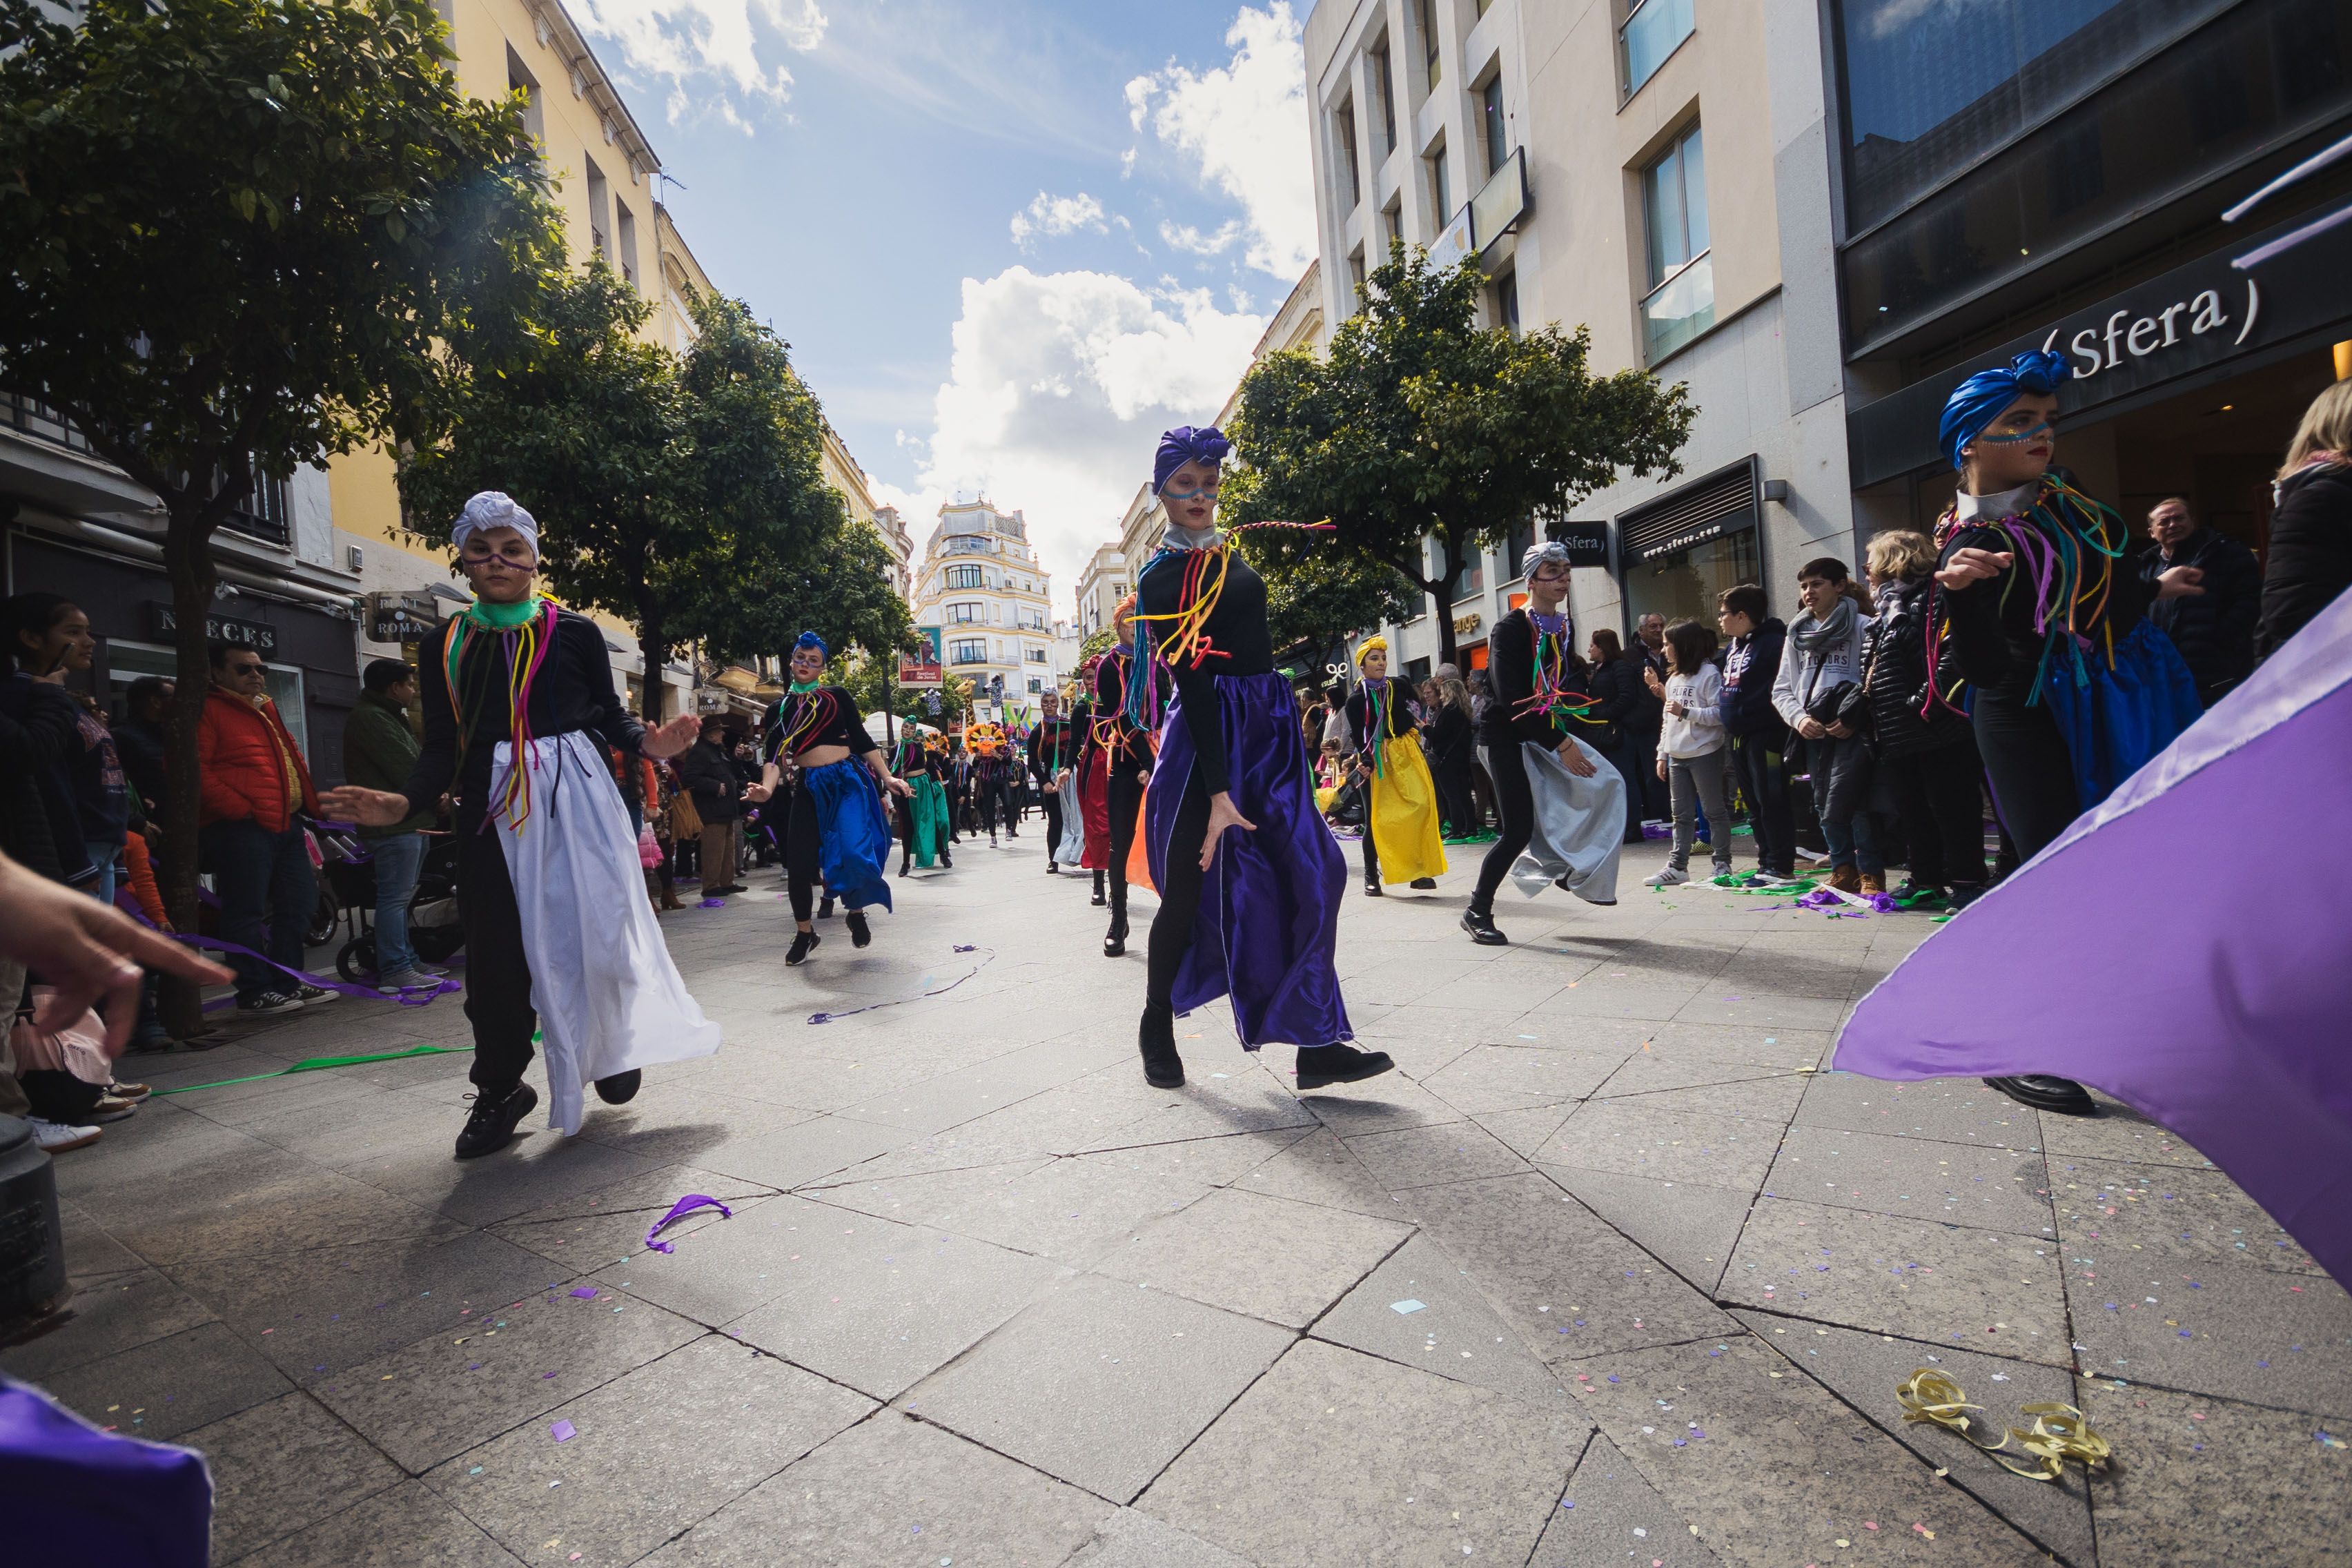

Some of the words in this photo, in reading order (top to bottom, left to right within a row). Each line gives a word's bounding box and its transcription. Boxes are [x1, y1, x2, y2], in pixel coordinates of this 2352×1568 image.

[1643, 525, 1722, 560] www.sfera.com
[160, 611, 275, 647] NECES
[378, 623, 424, 634] ROMA
[1453, 613, 1481, 633] ange
[1672, 687, 1694, 697] PLORE
